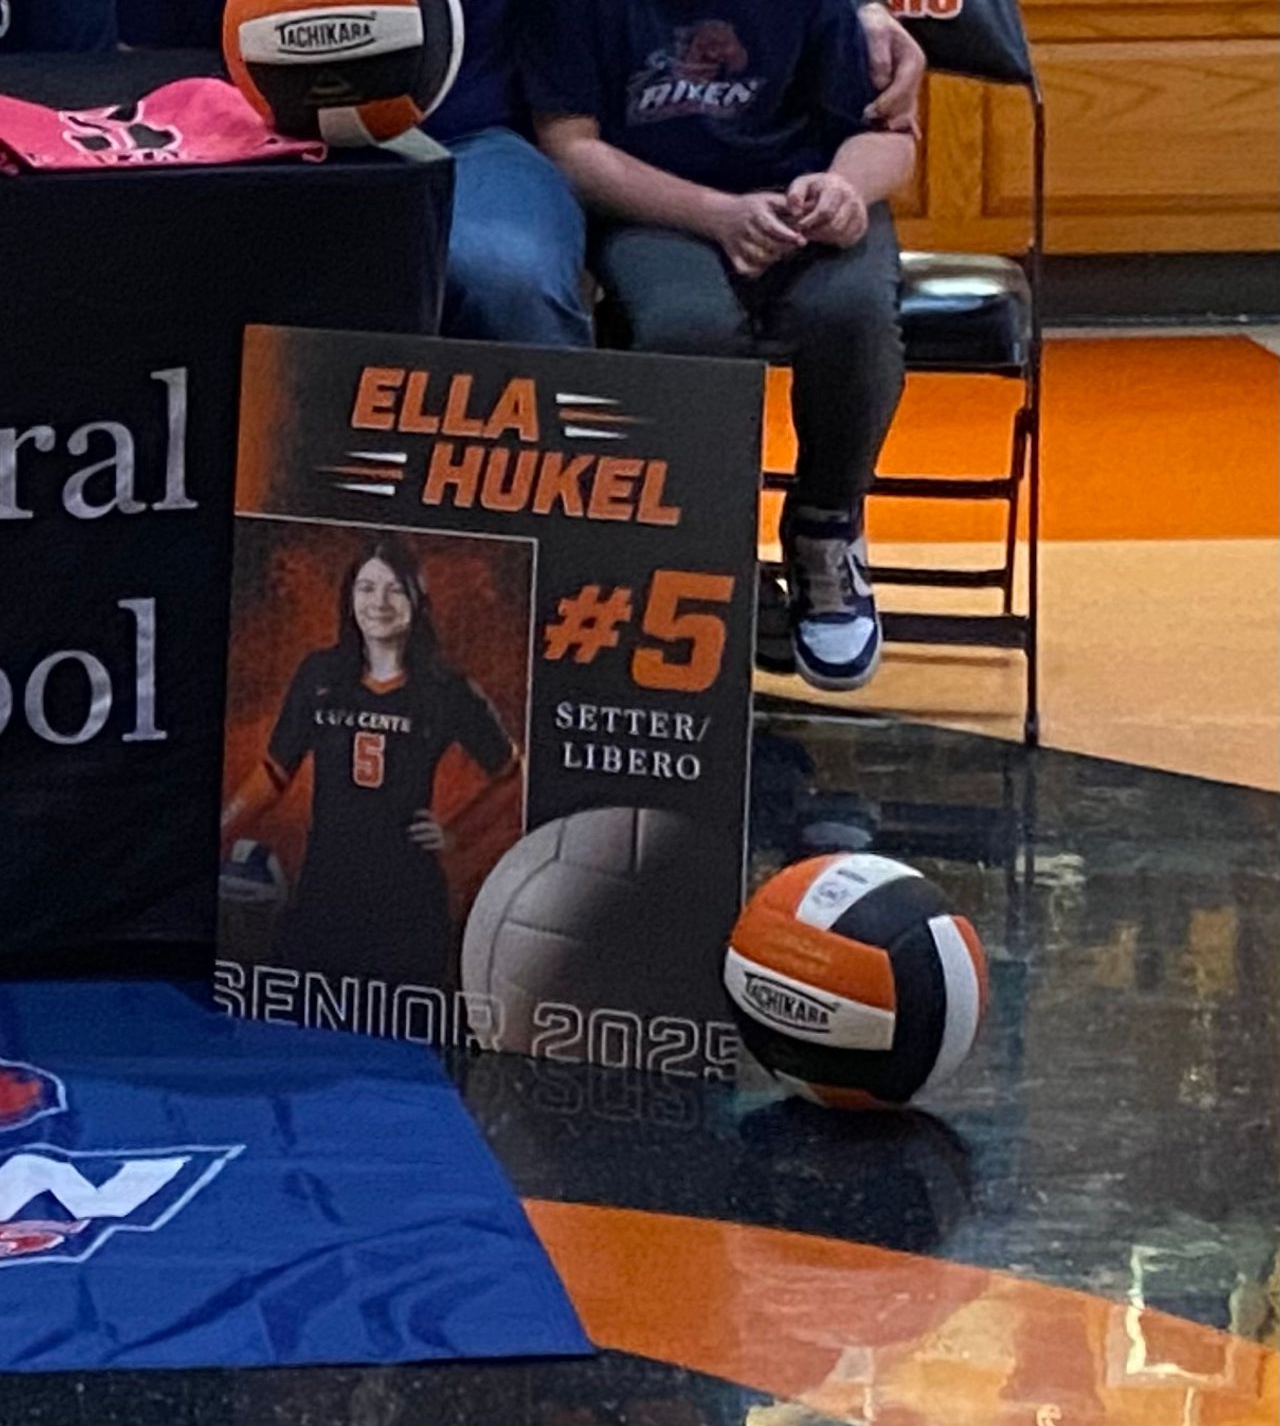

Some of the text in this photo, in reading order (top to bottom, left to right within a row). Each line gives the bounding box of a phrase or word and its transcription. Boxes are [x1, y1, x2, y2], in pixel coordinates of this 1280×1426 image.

[275, 19, 374, 51] TACHIKARA
[351, 366, 539, 442] ELLA
[421, 440, 682, 526] HUKEL
[543, 568, 736, 693] #5
[554, 701, 710, 743] SETTER/
[353, 730, 386, 789] 5
[561, 742, 702, 782] LIBERO
[213, 959, 744, 1080] SENIOR 2025
[742, 971, 834, 1030] TACHIKARA
